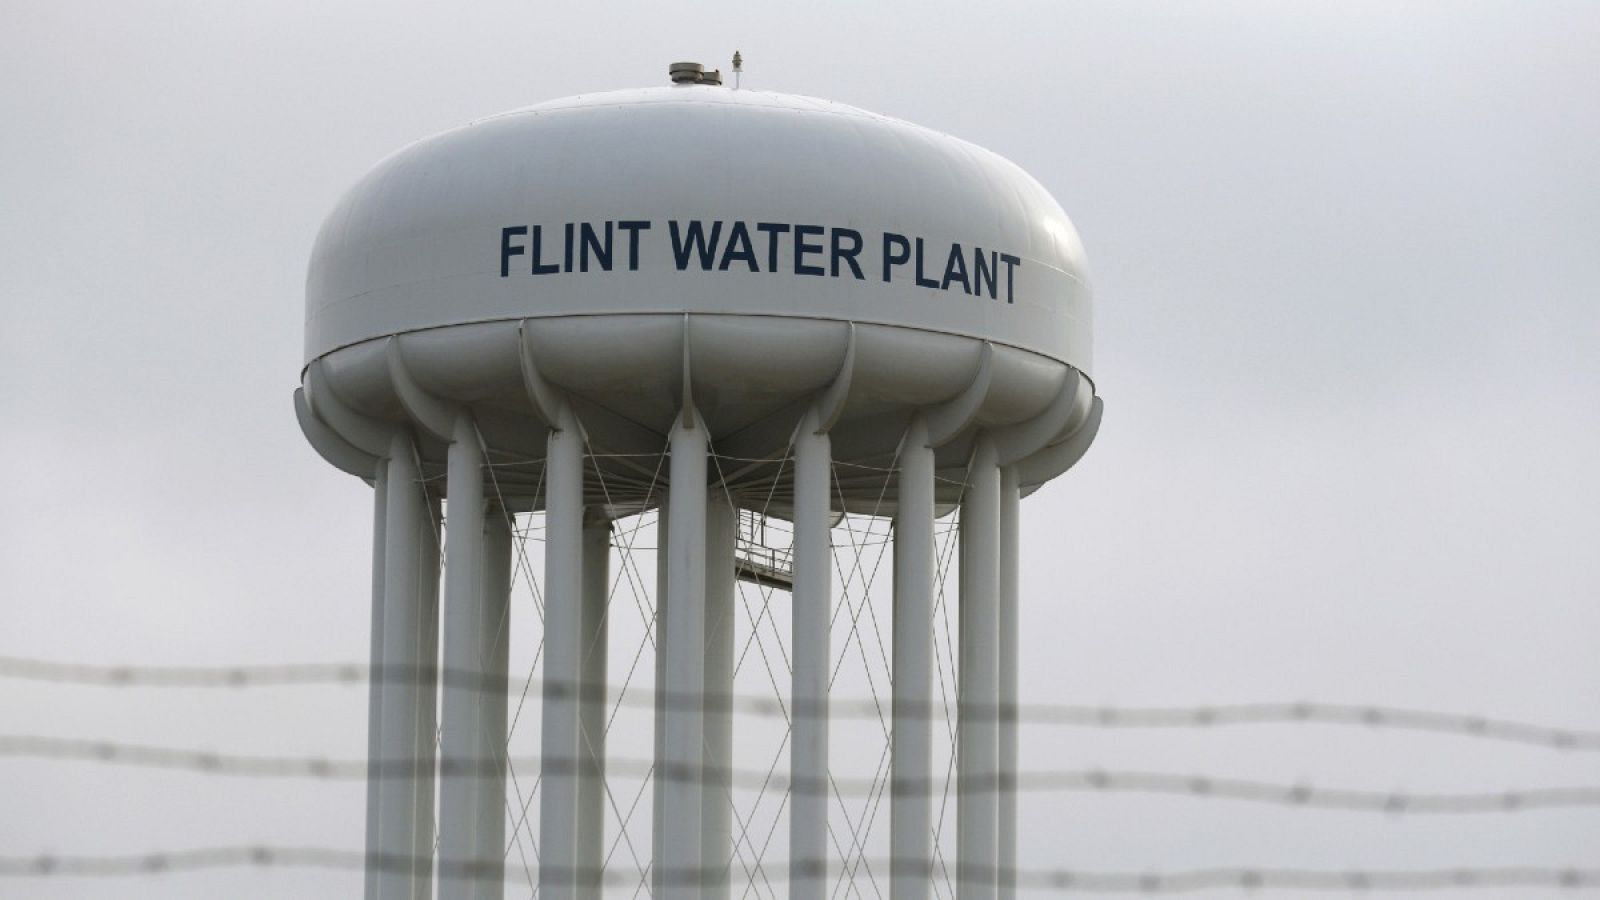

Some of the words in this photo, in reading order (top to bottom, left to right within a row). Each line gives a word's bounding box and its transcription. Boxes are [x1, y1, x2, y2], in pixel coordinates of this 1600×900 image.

[500, 220, 651, 278] FLINT
[668, 220, 866, 280] WATER
[882, 232, 1021, 304] PLANT
